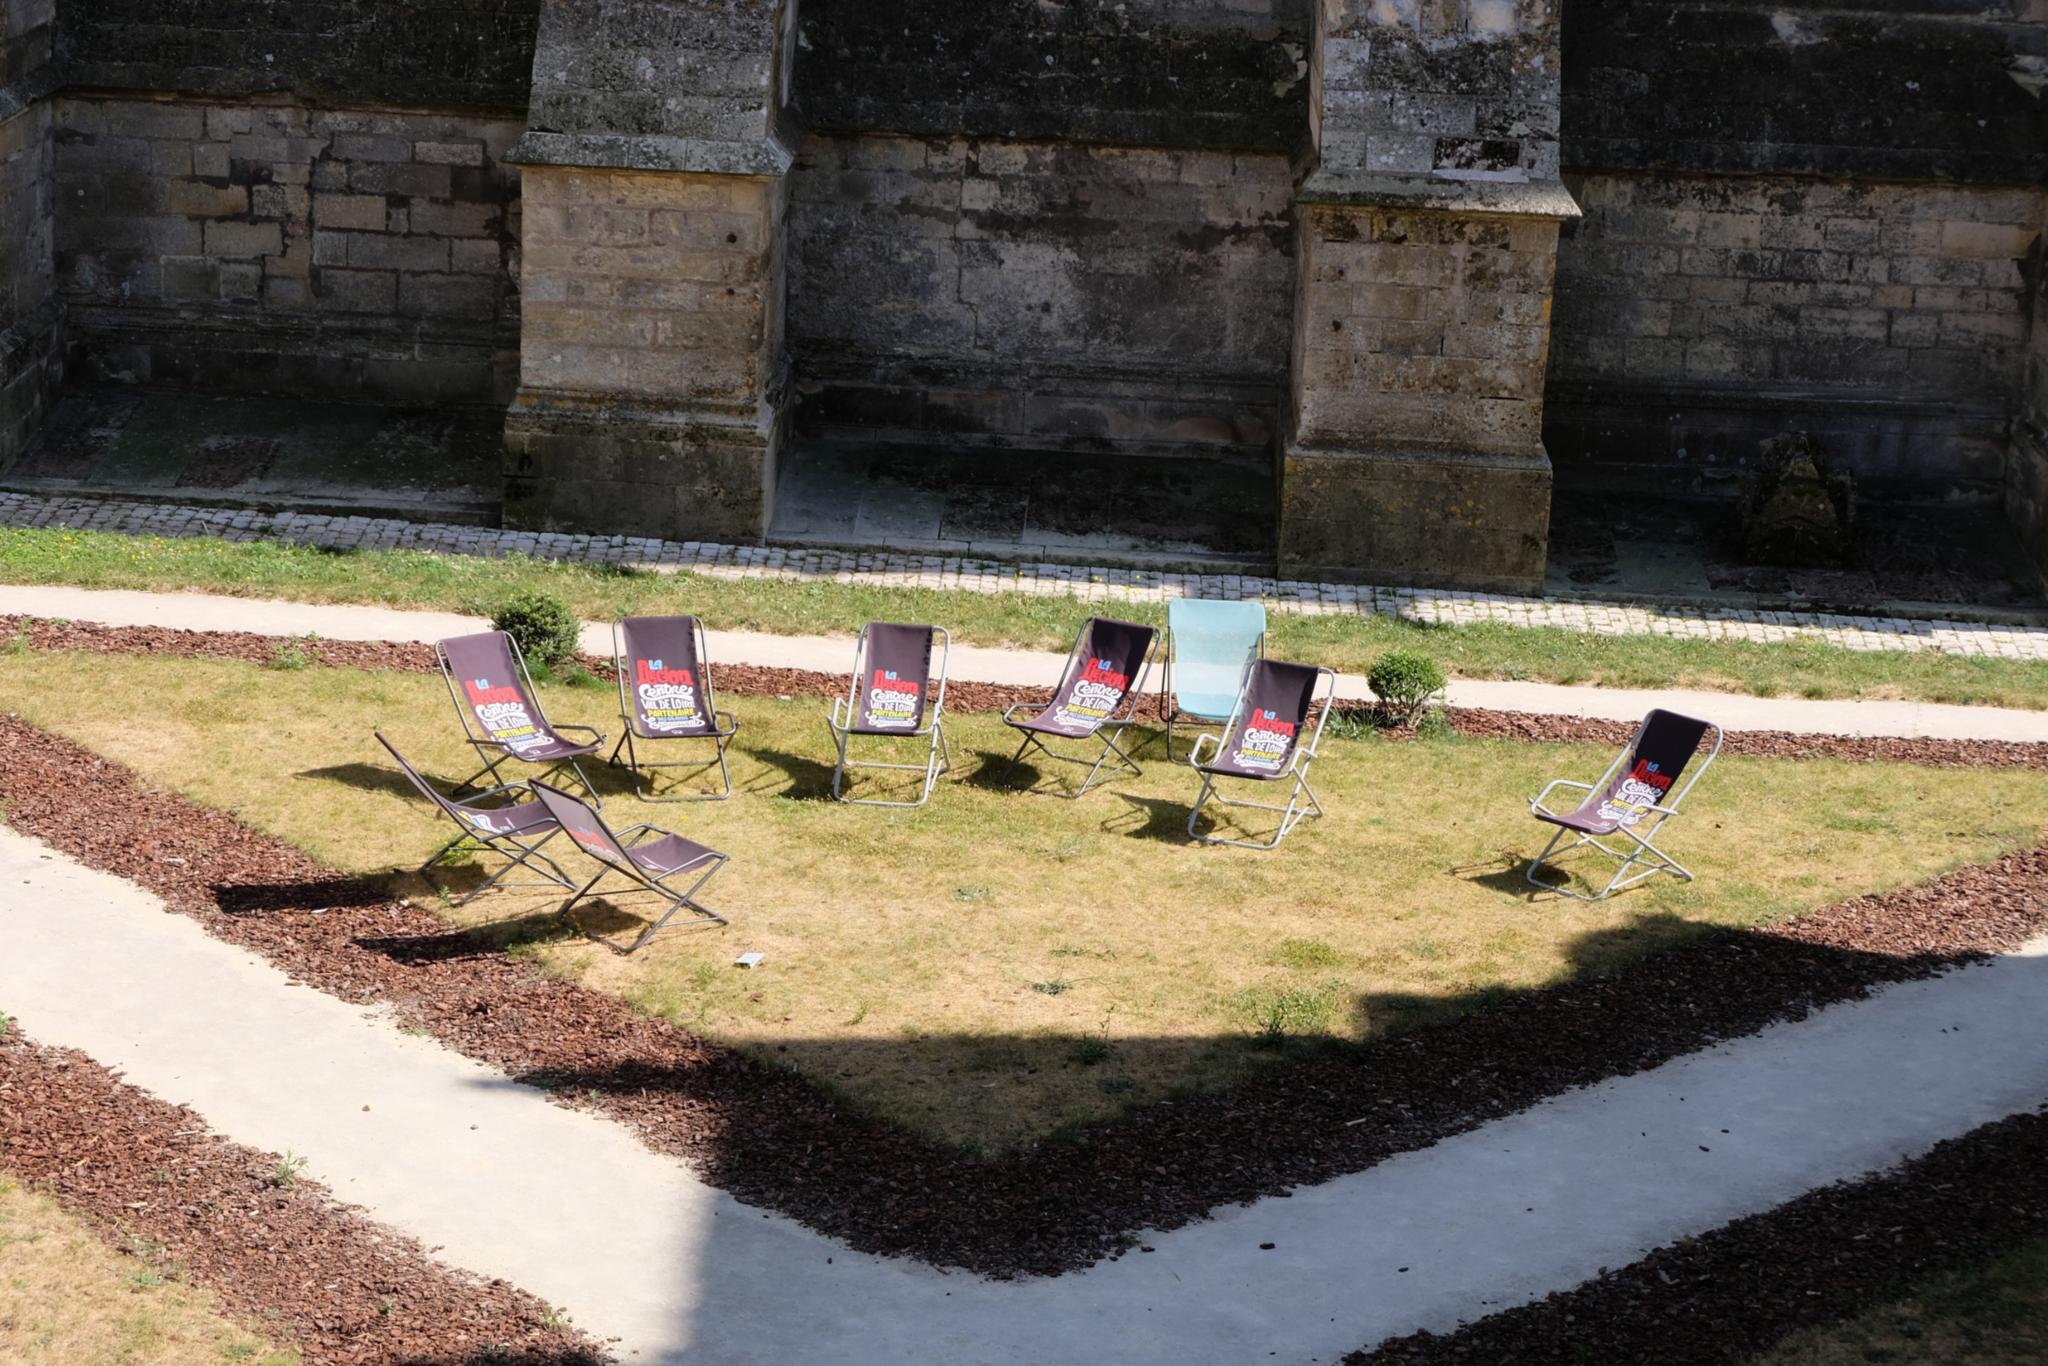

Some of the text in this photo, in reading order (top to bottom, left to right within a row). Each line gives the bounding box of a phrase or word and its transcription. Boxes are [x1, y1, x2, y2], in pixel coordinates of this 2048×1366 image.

[638, 683, 694, 701] Centre
[870, 688, 918, 705] Centre
[658, 699, 671, 709] DE
[884, 702, 895, 711] DE
[1244, 728, 1291, 748] Centre
[1255, 742, 1266, 752] DE
